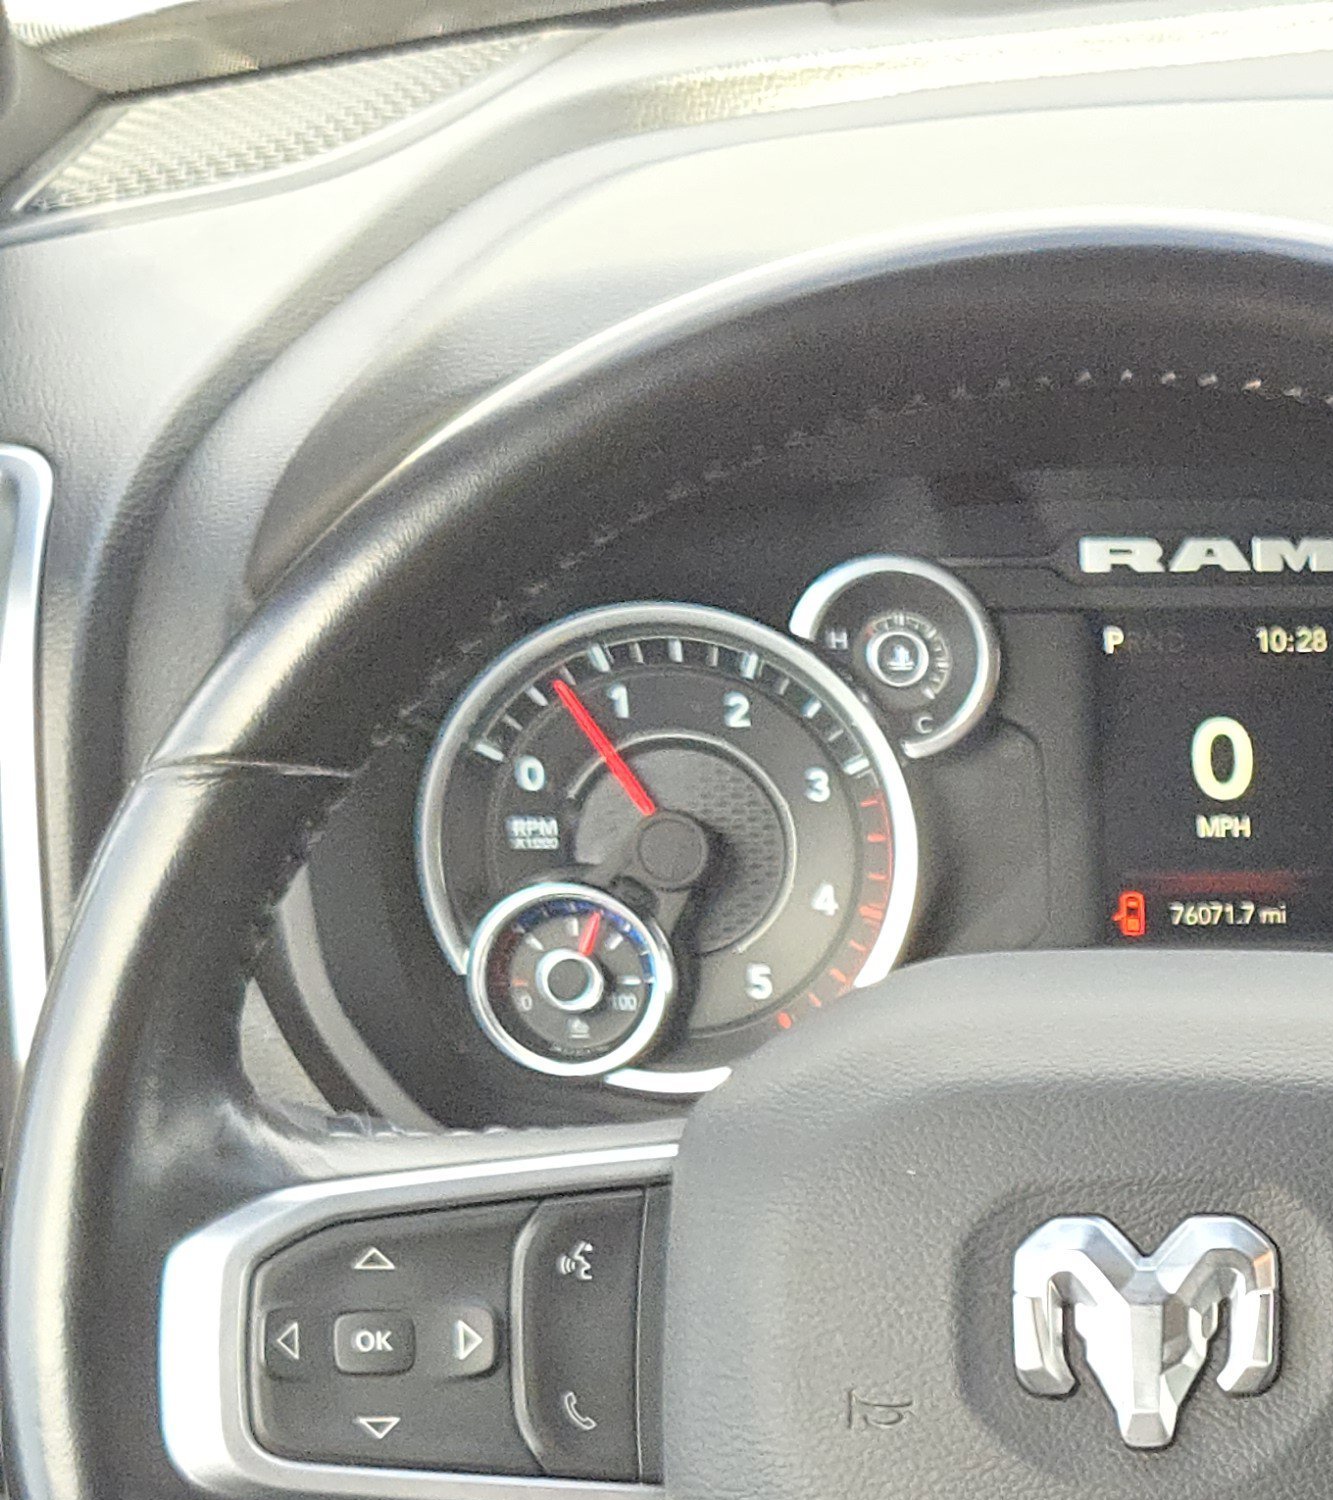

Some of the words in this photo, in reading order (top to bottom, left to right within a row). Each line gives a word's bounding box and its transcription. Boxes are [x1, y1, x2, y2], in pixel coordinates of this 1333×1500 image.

[825, 628, 848, 650] H
[1103, 625, 1125, 654] P
[1255, 625, 1328, 653] 10:28
[606, 683, 631, 719] 1
[723, 690, 751, 728] 2
[916, 715, 934, 734] C
[514, 754, 546, 792] 0
[1191, 716, 1254, 801] 0
[804, 766, 830, 802] 3
[506, 815, 559, 837] RPM
[1196, 815, 1251, 838] MPH
[811, 884, 838, 916] 4
[1170, 904, 1254, 926] 76071.7
[1260, 904, 1287, 925] mi
[745, 963, 773, 999] 5
[354, 1330, 393, 1353] OK
